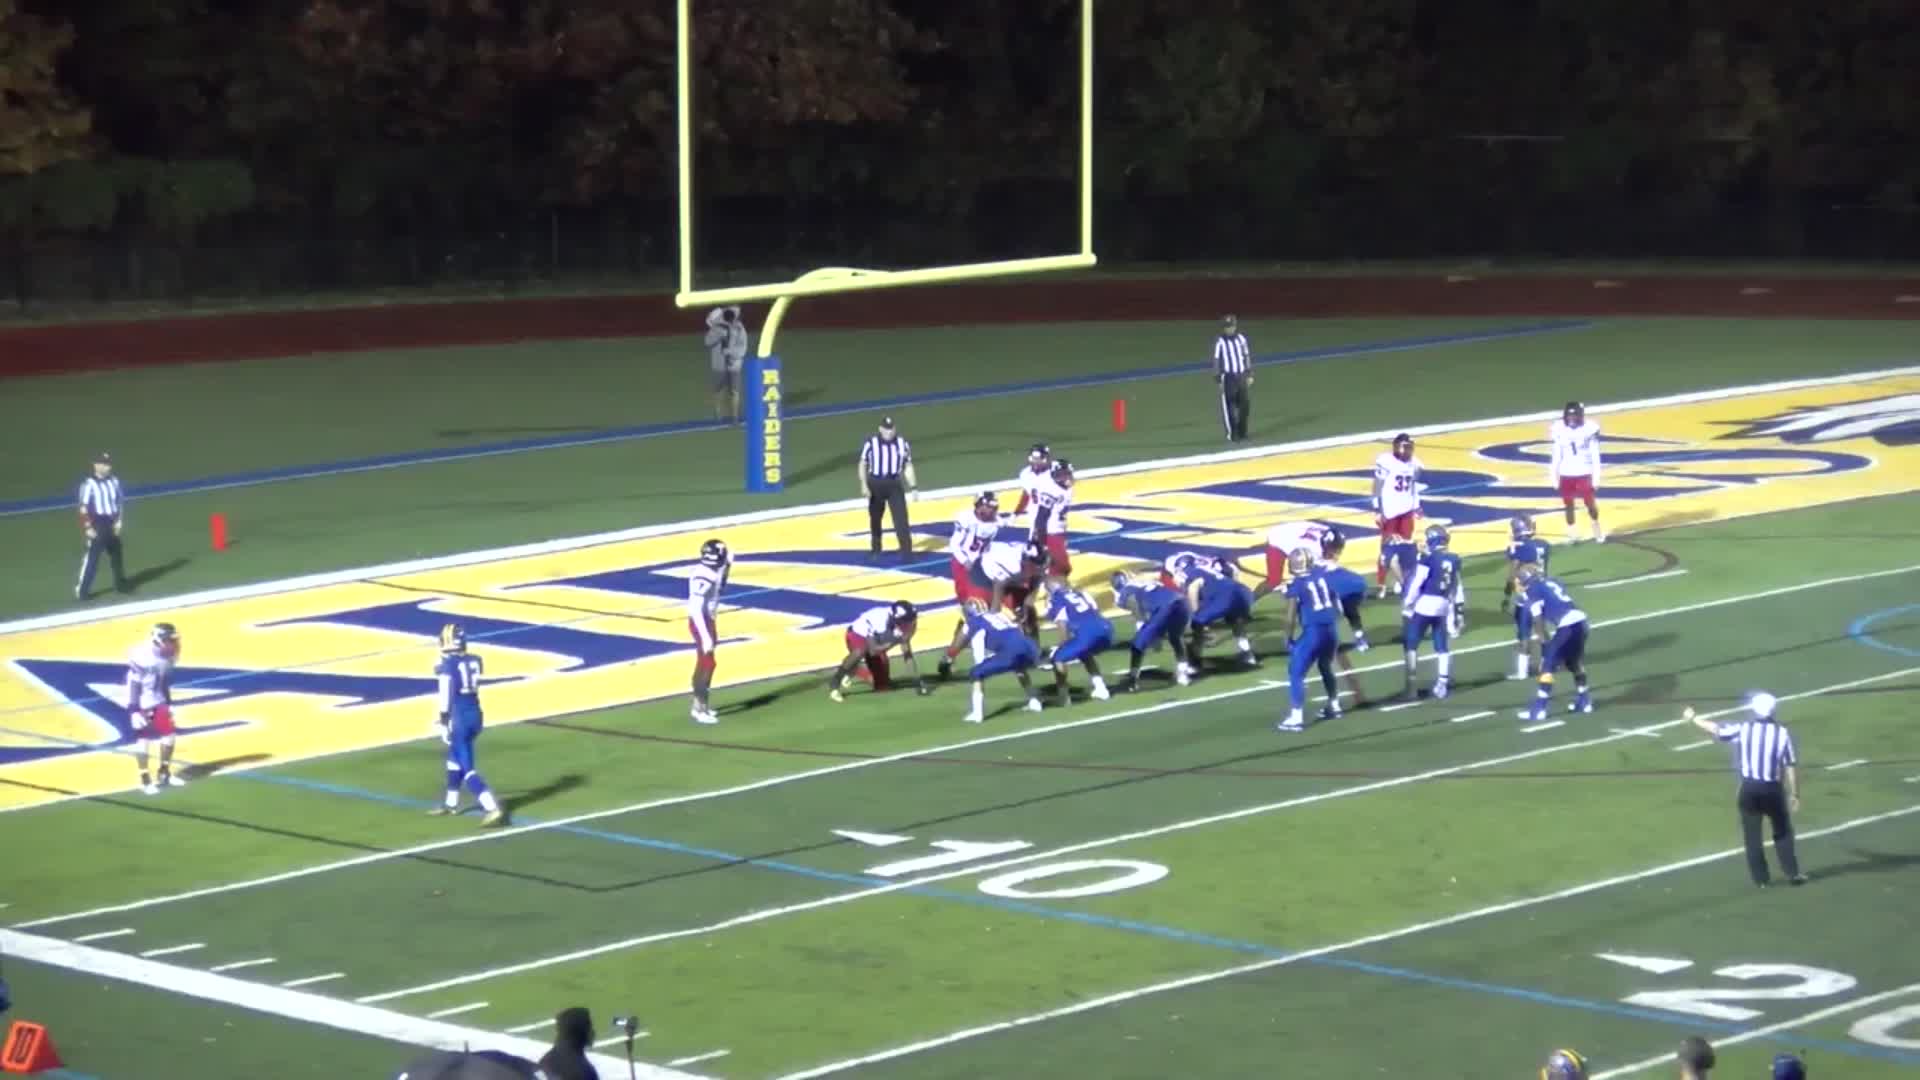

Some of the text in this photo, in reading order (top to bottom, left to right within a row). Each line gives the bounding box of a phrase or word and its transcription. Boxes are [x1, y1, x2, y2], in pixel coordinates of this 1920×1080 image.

[762, 369, 781, 484] RAIDERS
[0, 434, 1878, 765] AIDERS
[1308, 577, 1332, 611] 11
[863, 839, 1171, 899] 10
